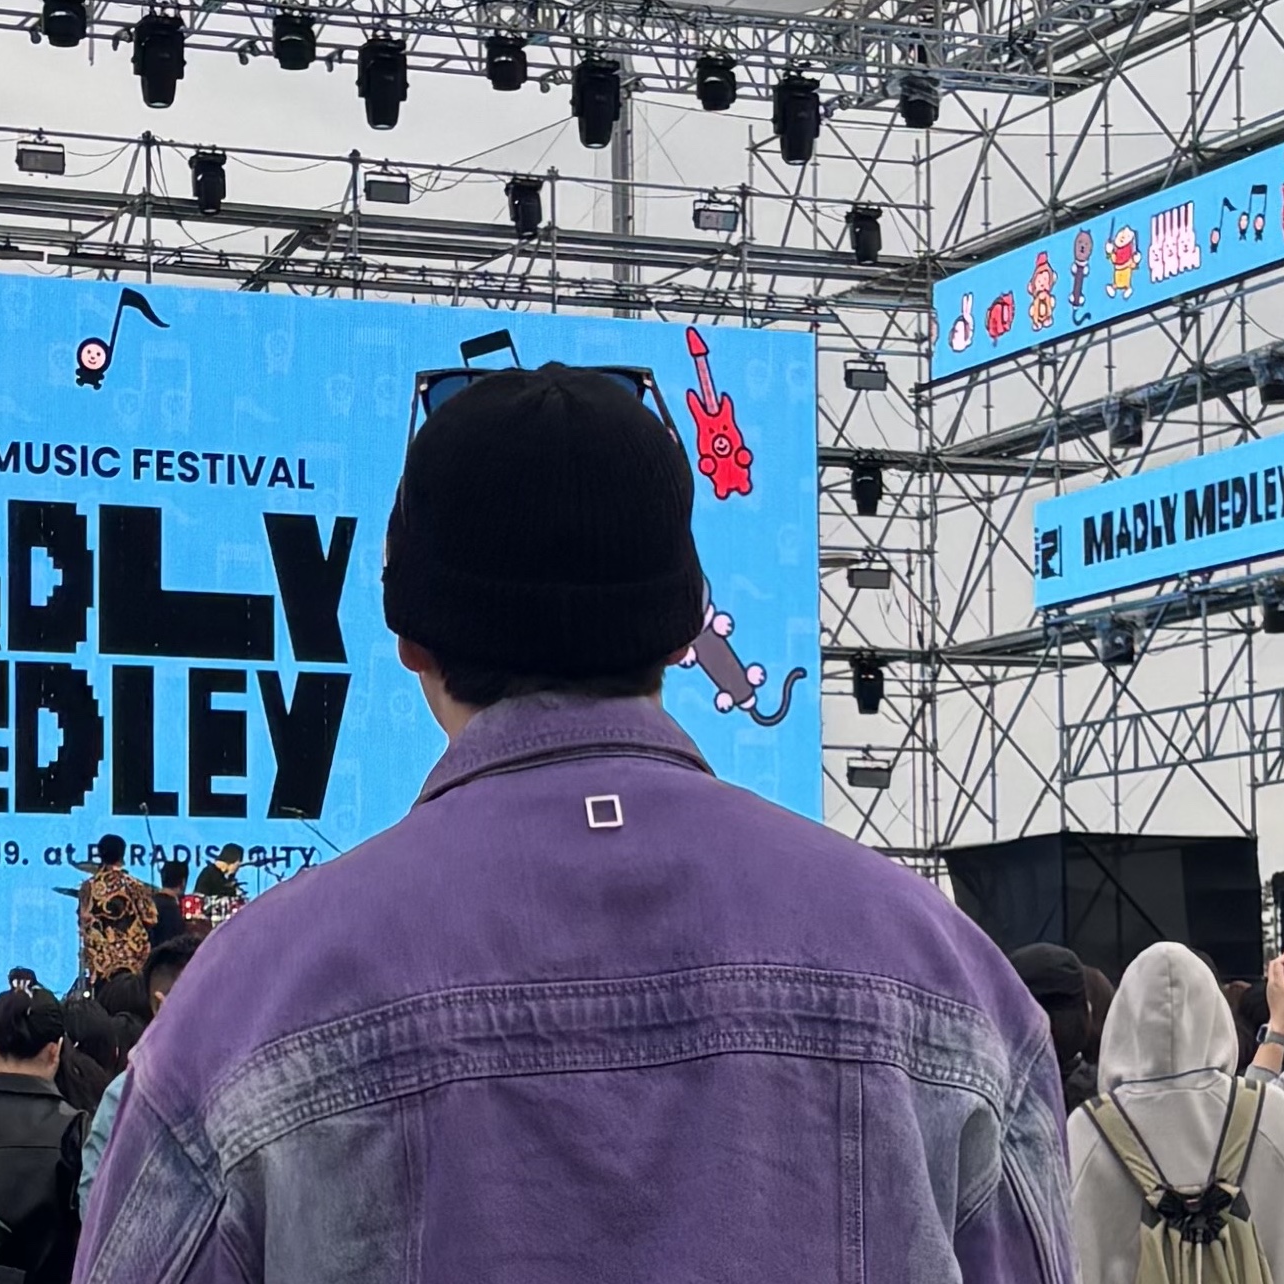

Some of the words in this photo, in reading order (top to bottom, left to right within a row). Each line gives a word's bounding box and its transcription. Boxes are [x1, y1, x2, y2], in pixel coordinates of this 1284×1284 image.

[132, 448, 315, 490] FESTIVAL
[1083, 493, 1178, 566] MADLY
[43, 842, 74, 866] at
